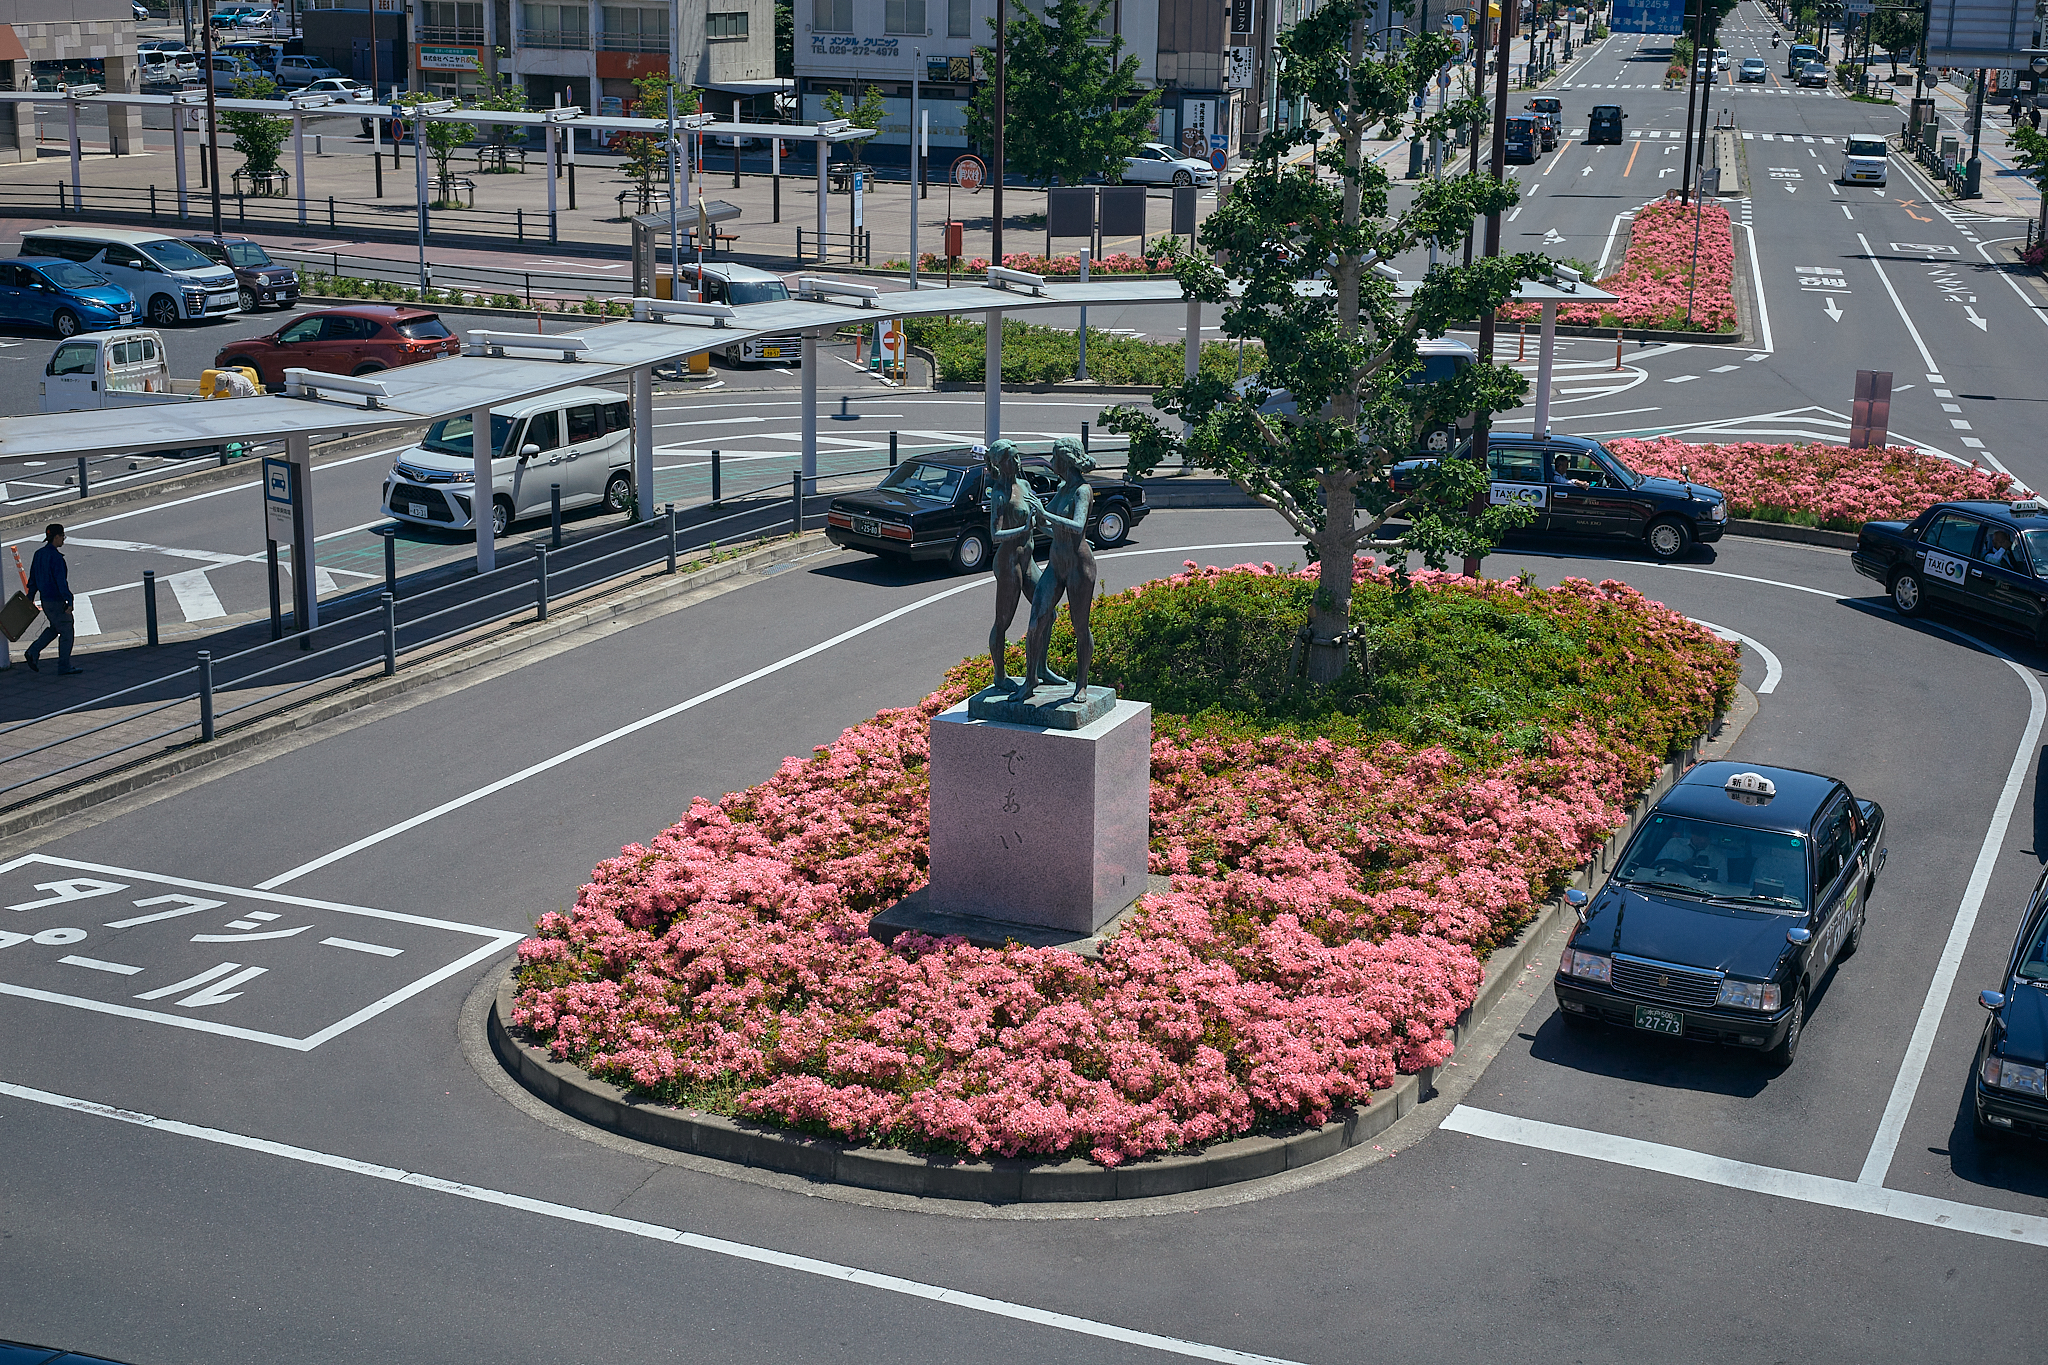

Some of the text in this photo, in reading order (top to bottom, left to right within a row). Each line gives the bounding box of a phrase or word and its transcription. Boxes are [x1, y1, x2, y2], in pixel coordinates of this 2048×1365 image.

[811, 36, 899, 47] アイ メンタル クリニック
[811, 45, 828, 54] TEL
[1928, 558, 1944, 570] TAXI
[1000, 750, 1024, 849] であい
[4, 878, 405, 958] タクシー
[1645, 1016, 1680, 1033] 27-73
